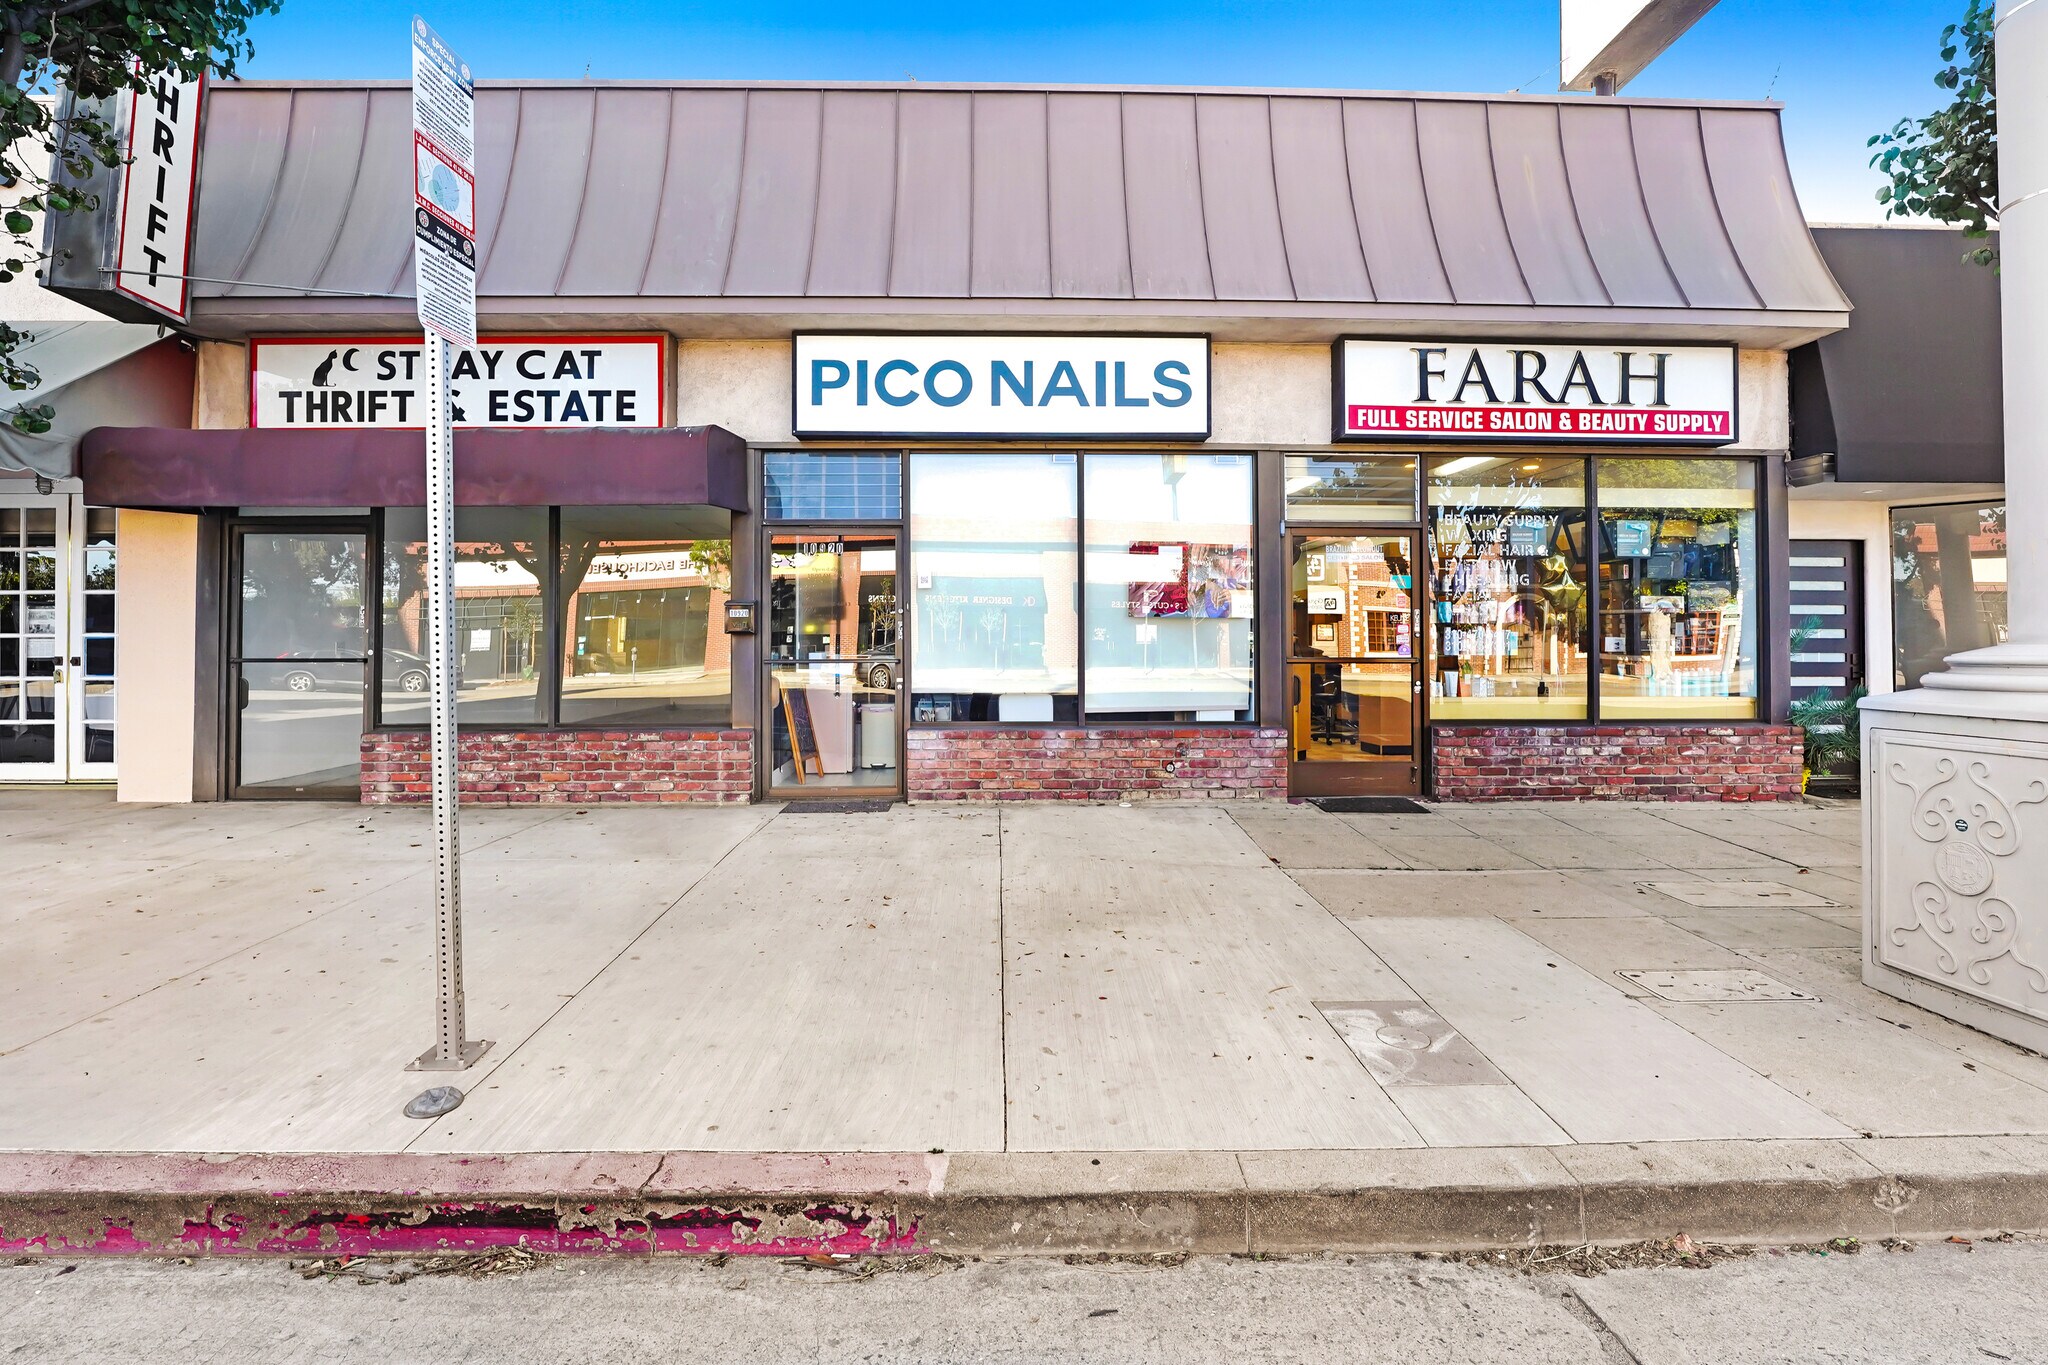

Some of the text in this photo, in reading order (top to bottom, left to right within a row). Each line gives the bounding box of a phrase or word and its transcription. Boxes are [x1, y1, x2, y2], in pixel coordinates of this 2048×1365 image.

[414, 31, 472, 96] ENFORCEMENT ZONE
[431, 36, 456, 68] SPECIAL
[432, 145, 452, 168] SECTIONS
[144, 68, 179, 287] HRIFT
[432, 205, 454, 226] SECCIONES
[417, 224, 474, 268] CUMPLIMIENTO ESPECIAL
[436, 225, 456, 245] ZONA DE
[377, 350, 602, 380] STAY CAT
[1410, 347, 1673, 408] FARAH
[811, 359, 1192, 407] PICO NAILS
[279, 391, 414, 423] THRIFT
[489, 390, 636, 422] ESTATE
[1357, 408, 1724, 433] FULL SERVICE SALON & BEAUTY SUPPLY
[1444, 514, 1559, 527] BEAUTY SUPPLY
[804, 542, 843, 556] 10920
[1446, 530, 1507, 542] WAXING
[1446, 544, 1495, 556] FACIAL
[1500, 544, 1533, 556] HAIR
